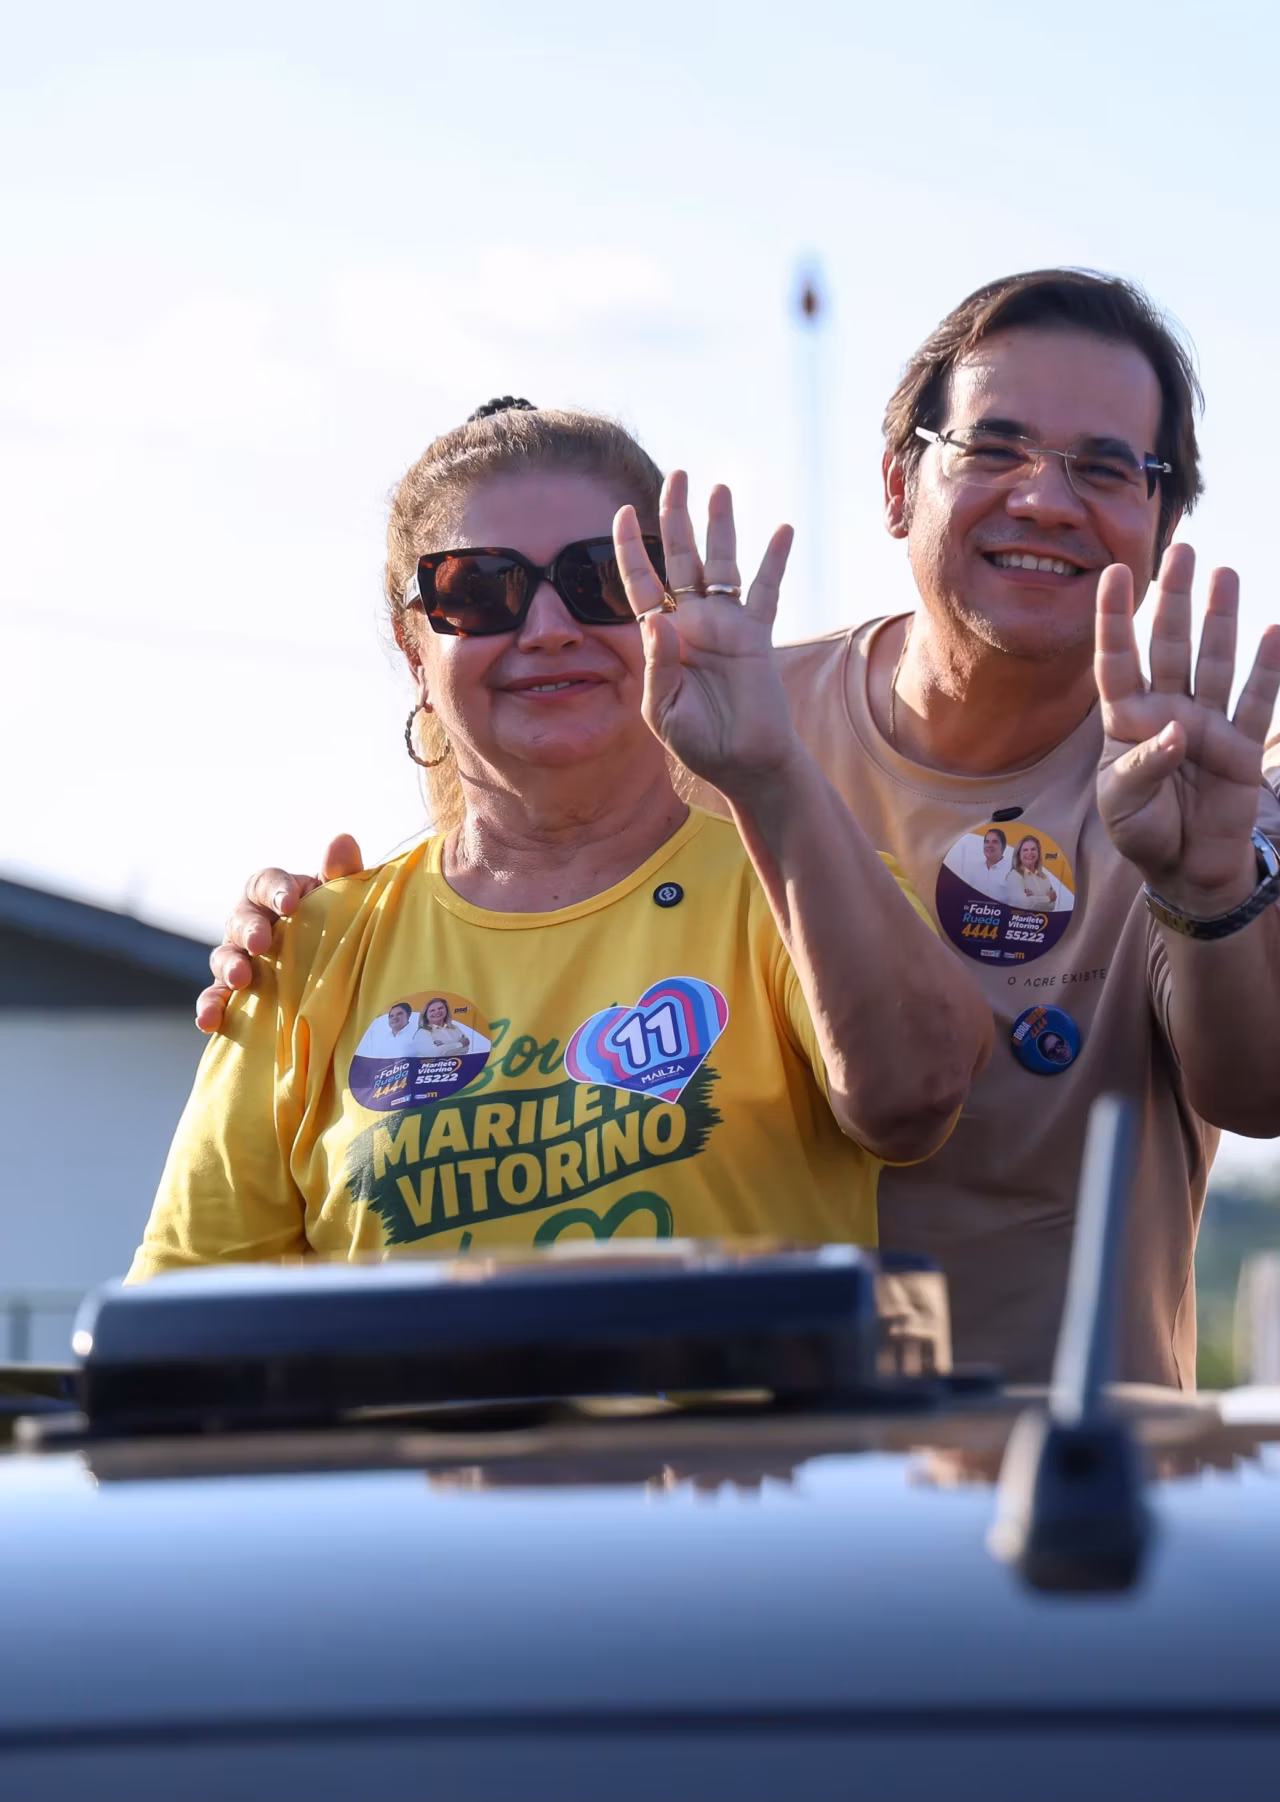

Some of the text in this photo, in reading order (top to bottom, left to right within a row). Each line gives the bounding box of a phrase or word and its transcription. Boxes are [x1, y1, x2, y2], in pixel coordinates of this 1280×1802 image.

[962, 912, 1000, 925] Rueda
[969, 904, 1001, 917] Fabio
[1008, 920, 1040, 931] Vitorino
[1011, 914, 1044, 925] Marilete
[961, 923, 999, 939] 4444
[1005, 929, 1045, 943] 55222
[1007, 976, 1016, 986] O
[1062, 968, 1107, 984] EXISTE
[614, 1004, 679, 1067] 11
[379, 1062, 410, 1079] Fabio
[418, 1066, 453, 1075] Vitorino
[421, 1060, 457, 1069] Marilete
[373, 1070, 409, 1088] Rueda
[415, 1073, 459, 1085] 55222
[641, 1065, 685, 1083] MAILZA
[372, 1077, 408, 1099] 4444
[373, 1083, 652, 1179] MARILE
[395, 1102, 687, 1227] VITORINO
